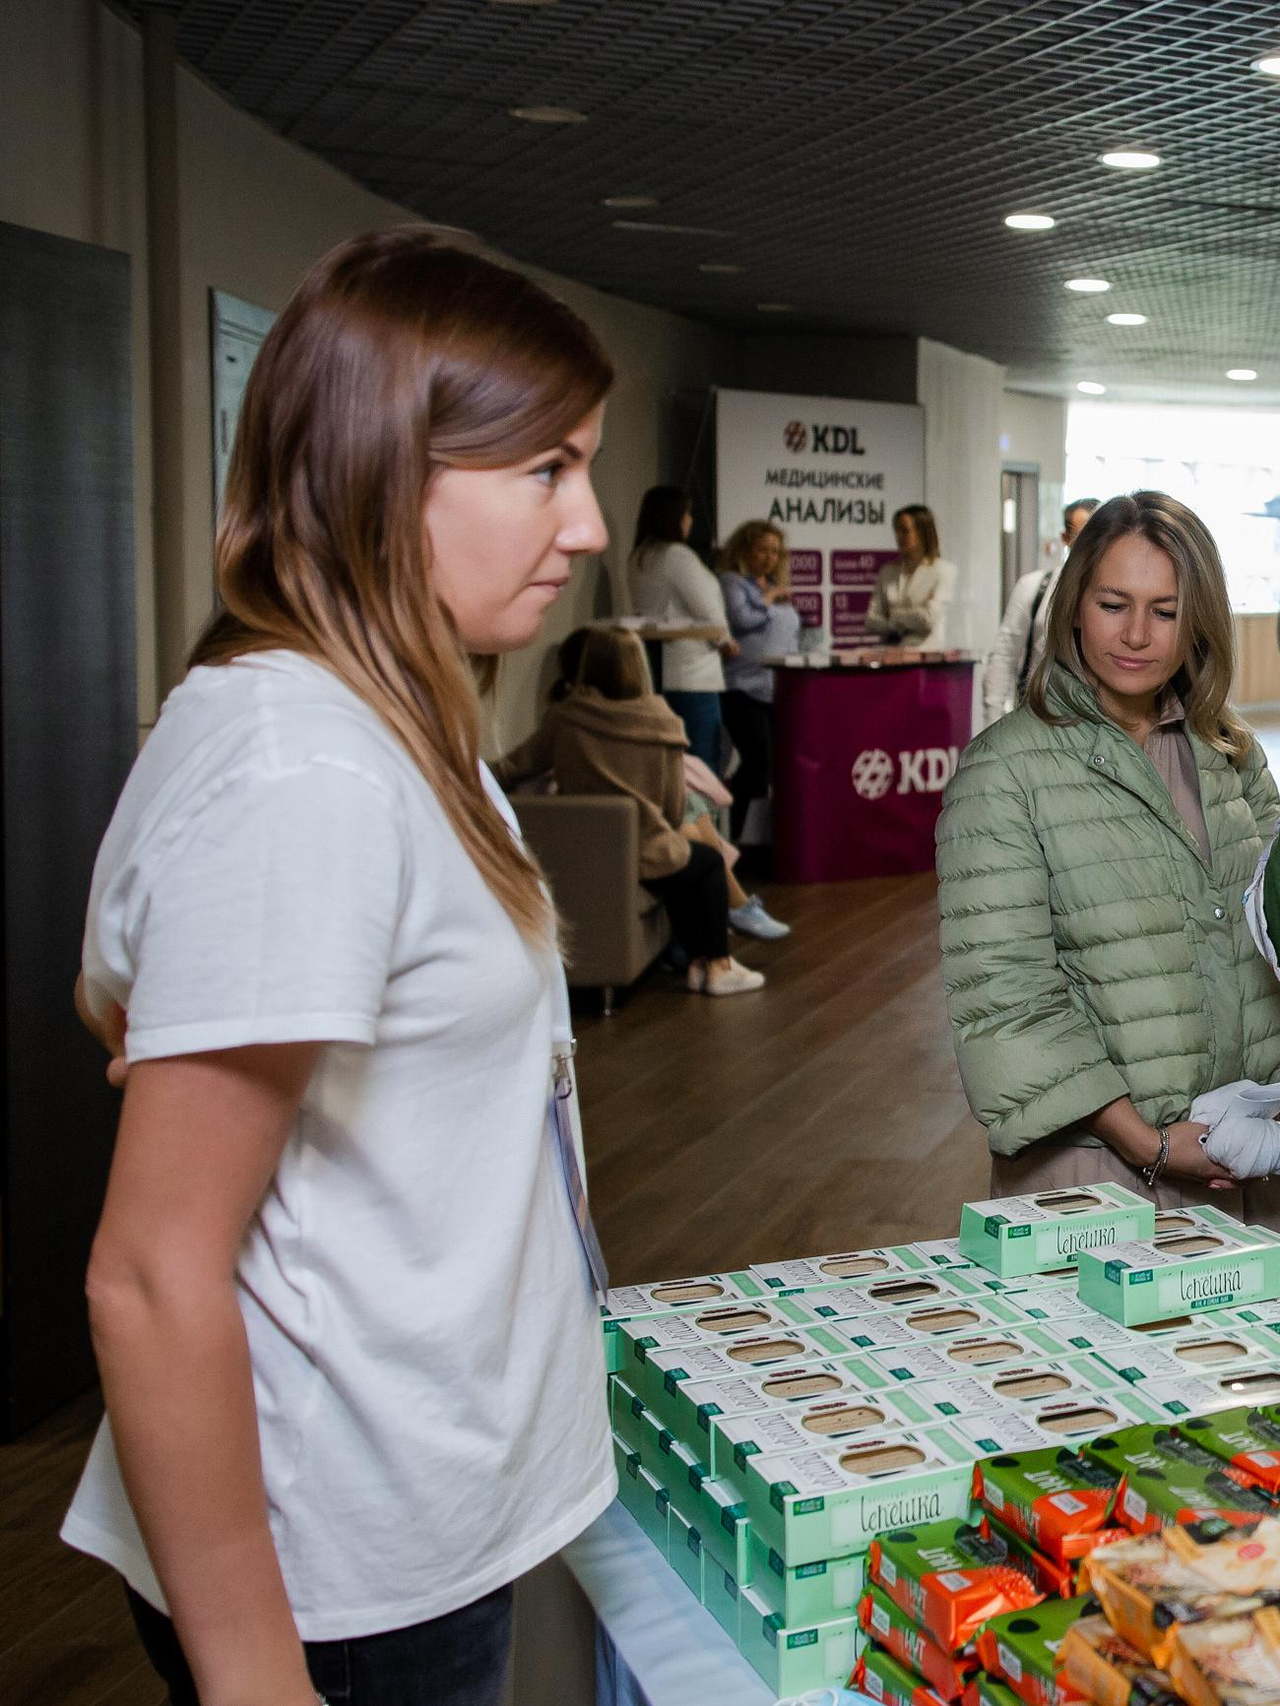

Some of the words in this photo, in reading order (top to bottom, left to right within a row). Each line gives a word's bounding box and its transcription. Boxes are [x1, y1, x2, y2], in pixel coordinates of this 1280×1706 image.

[811, 424, 865, 455] KDL
[765, 468, 885, 490] МЕДИЦИНСКИЕ
[768, 497, 885, 525] АНАЛИЗЫ
[896, 747, 958, 796] KD
